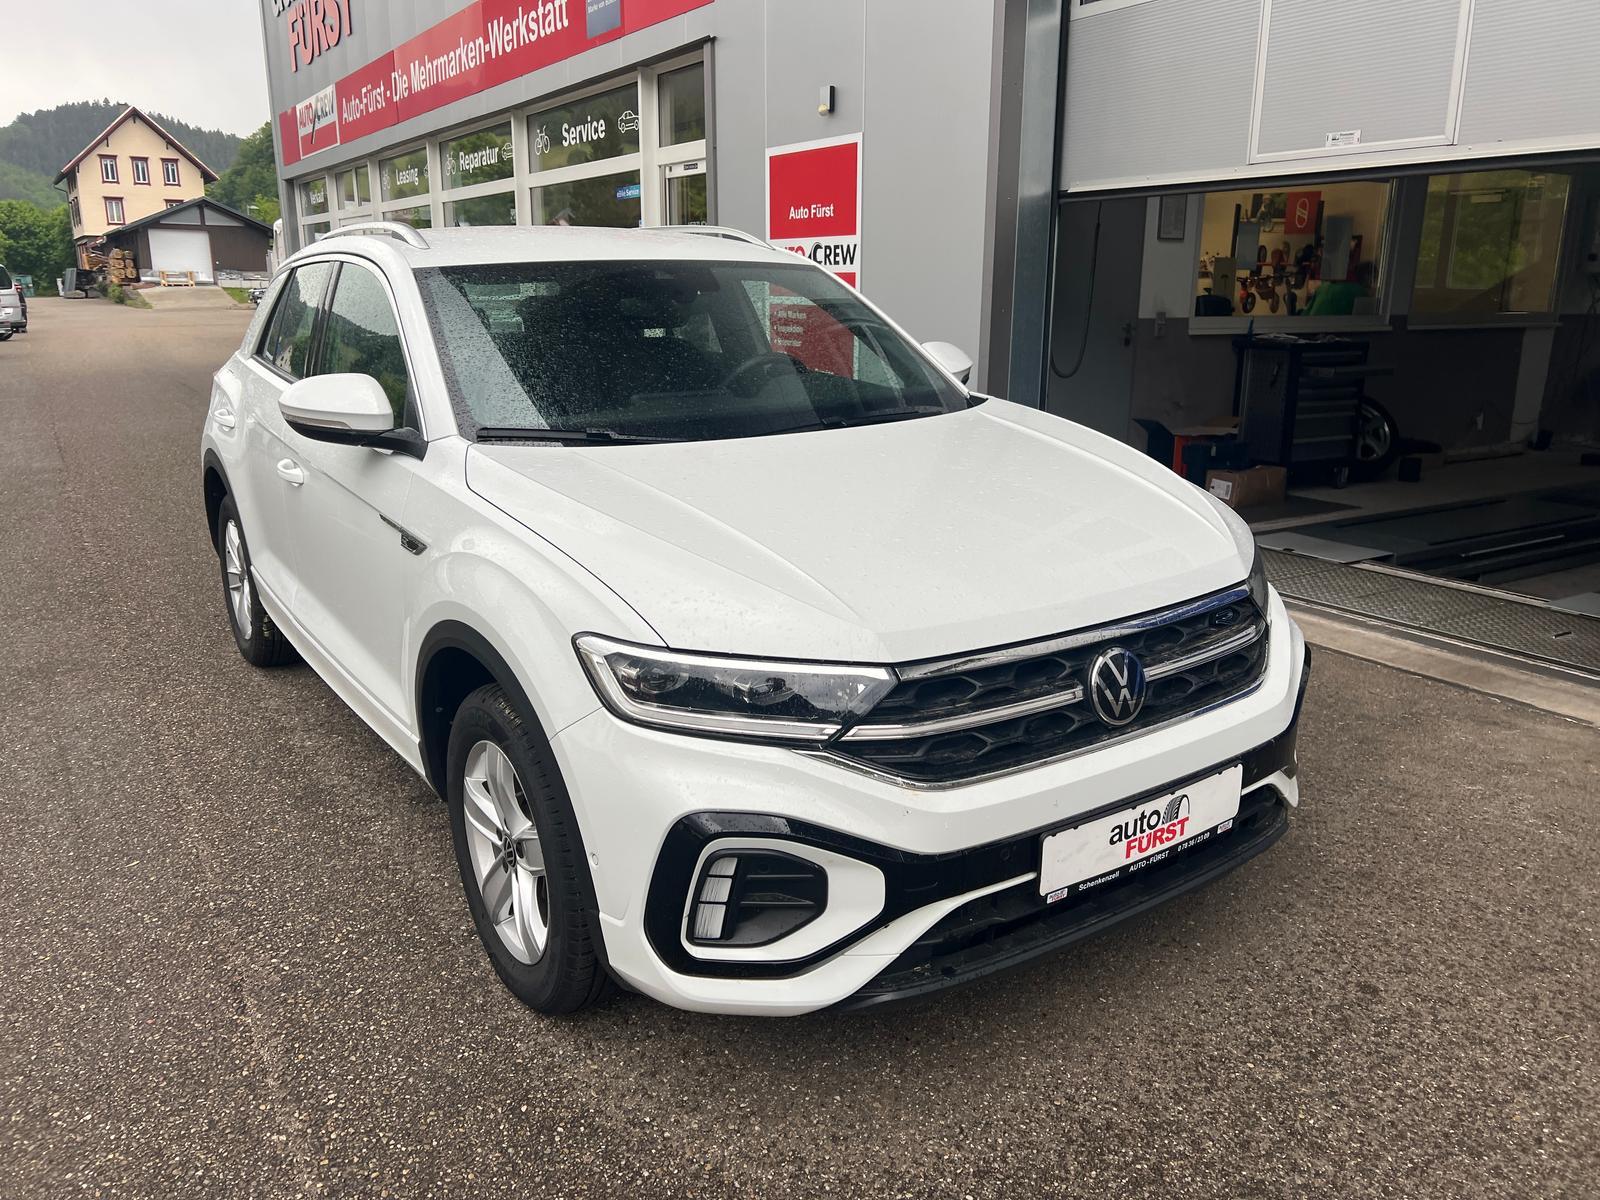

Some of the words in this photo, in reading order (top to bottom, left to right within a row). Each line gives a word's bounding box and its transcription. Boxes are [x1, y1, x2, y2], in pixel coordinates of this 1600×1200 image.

[342, 84, 385, 125] Auto-Fürst
[391, 69, 409, 102] Die
[410, 0, 569, 95] Mehrmarken-Werkstatt
[561, 115, 606, 148] Service
[396, 165, 419, 187] Leasing
[459, 146, 500, 174] Reparatur
[789, 206, 808, 219] Auto
[811, 204, 834, 218] Fürst
[813, 244, 858, 266] CREW
[1109, 809, 1161, 846] auto
[1125, 818, 1190, 859] FÜRST
[1079, 871, 1120, 890] Schenkenzell
[1129, 860, 1147, 872] AUTO
[1151, 851, 1170, 864] FÜRST
